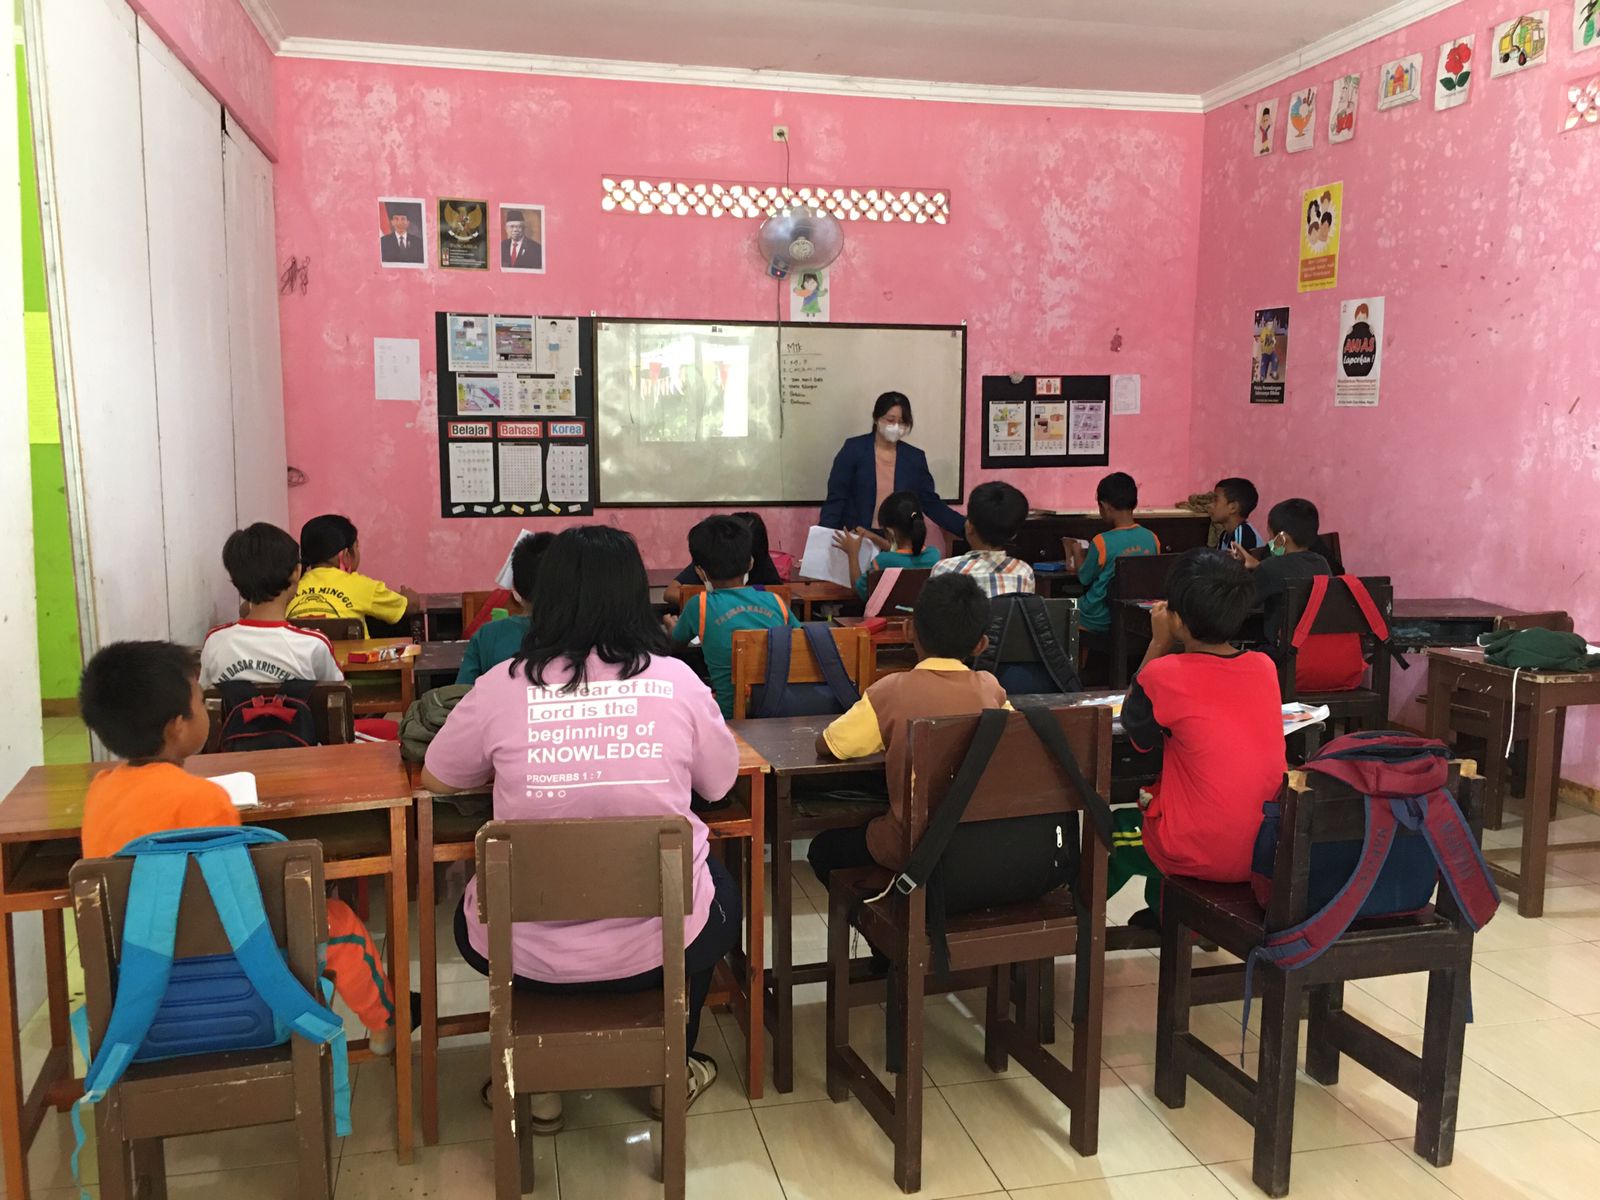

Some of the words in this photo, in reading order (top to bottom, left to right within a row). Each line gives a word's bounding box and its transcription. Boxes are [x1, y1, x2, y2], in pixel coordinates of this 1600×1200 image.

[1344, 337, 1374, 353] AWAS
[452, 424, 488, 436] Belajar
[502, 424, 538, 435] Bahasa
[552, 424, 582, 434] Korea
[318, 587, 354, 608] MINGGU
[226, 659, 254, 677] DASAR
[528, 686, 565, 700] The
[618, 680, 640, 694] of
[644, 680, 672, 696] the
[529, 705, 574, 721] Lord
[582, 703, 597, 718] is
[605, 702, 636, 715] the
[528, 722, 628, 744] beginning
[636, 721, 656, 736] of
[527, 743, 664, 764] KNOWLEDGE
[526, 772, 580, 783] PROVERBS
